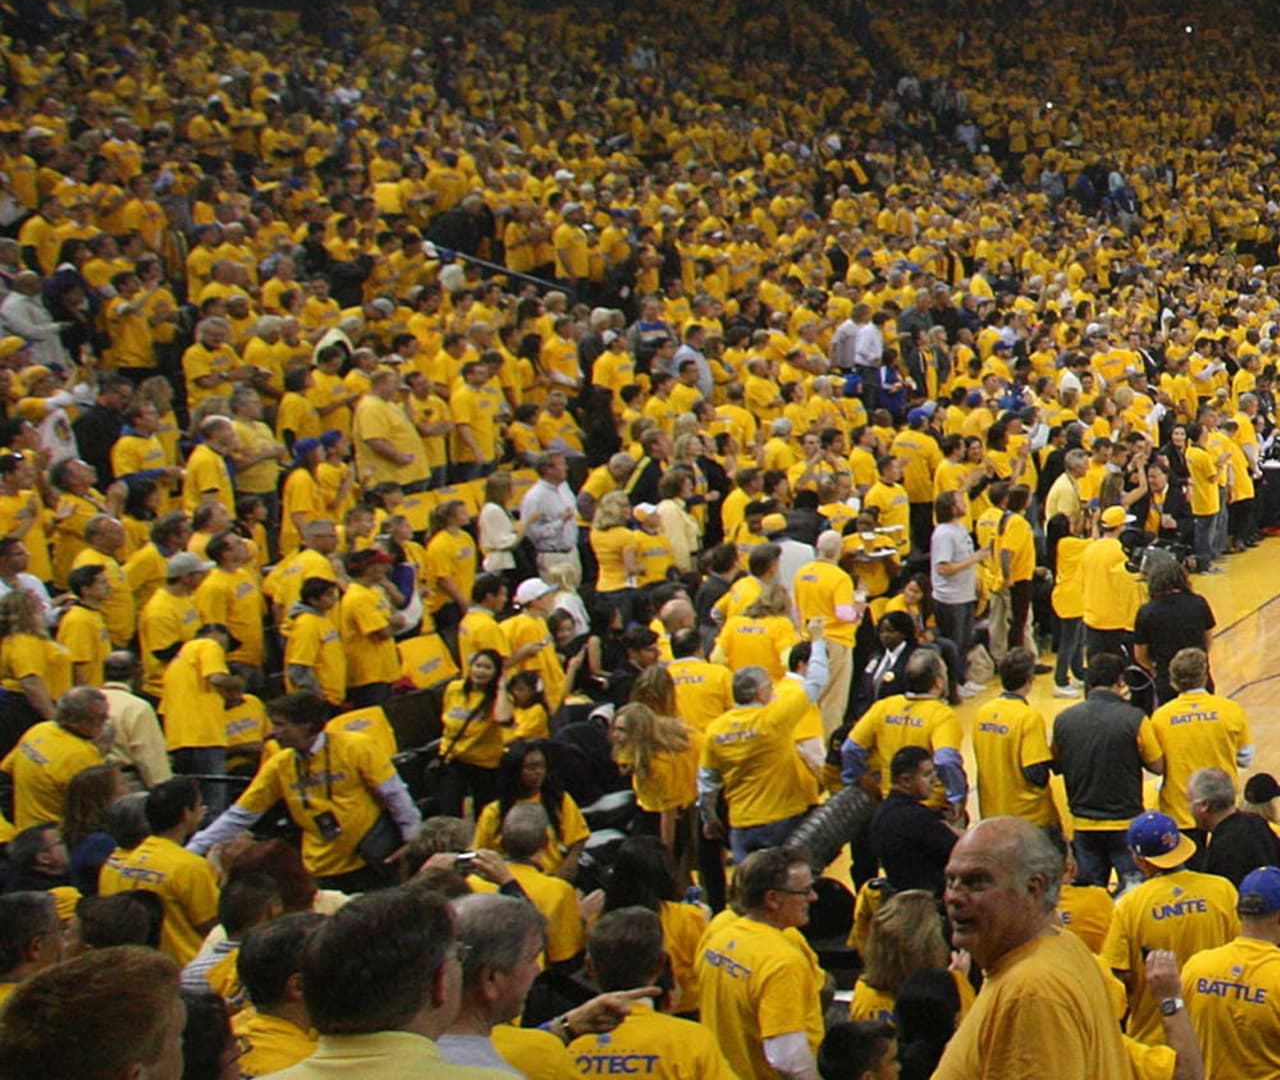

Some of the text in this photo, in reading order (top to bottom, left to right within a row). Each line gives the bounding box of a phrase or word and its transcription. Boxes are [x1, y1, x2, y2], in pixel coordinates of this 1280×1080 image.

[1169, 710, 1219, 725] BATTLE
[1152, 899, 1208, 920] UNITE
[1197, 978, 1268, 1004] BATTLE
